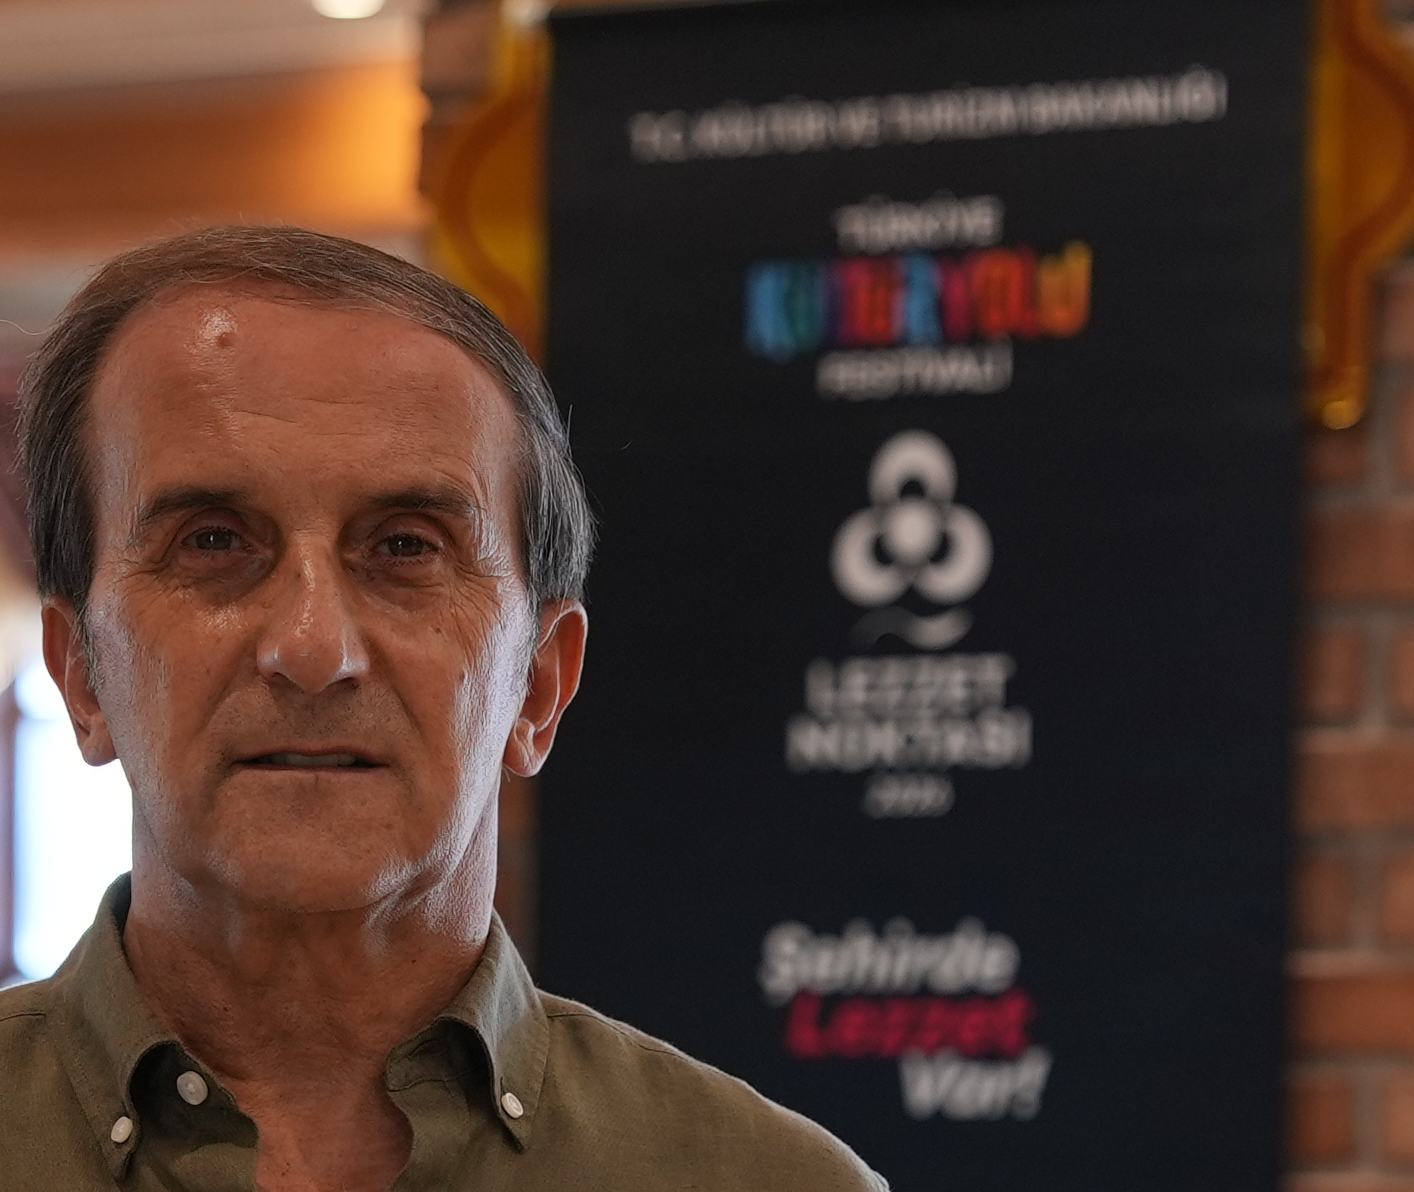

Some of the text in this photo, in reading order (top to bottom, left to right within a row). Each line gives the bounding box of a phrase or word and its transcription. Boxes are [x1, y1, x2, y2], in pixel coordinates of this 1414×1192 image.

[818, 340, 1012, 396] FESTİVALİ
[807, 658, 1012, 713] LEZZET
[787, 708, 1031, 768] NOKTASI
[759, 921, 1017, 1000] Şehirde
[788, 989, 1034, 1053] Lezzet
[902, 1050, 1051, 1116] Var!
